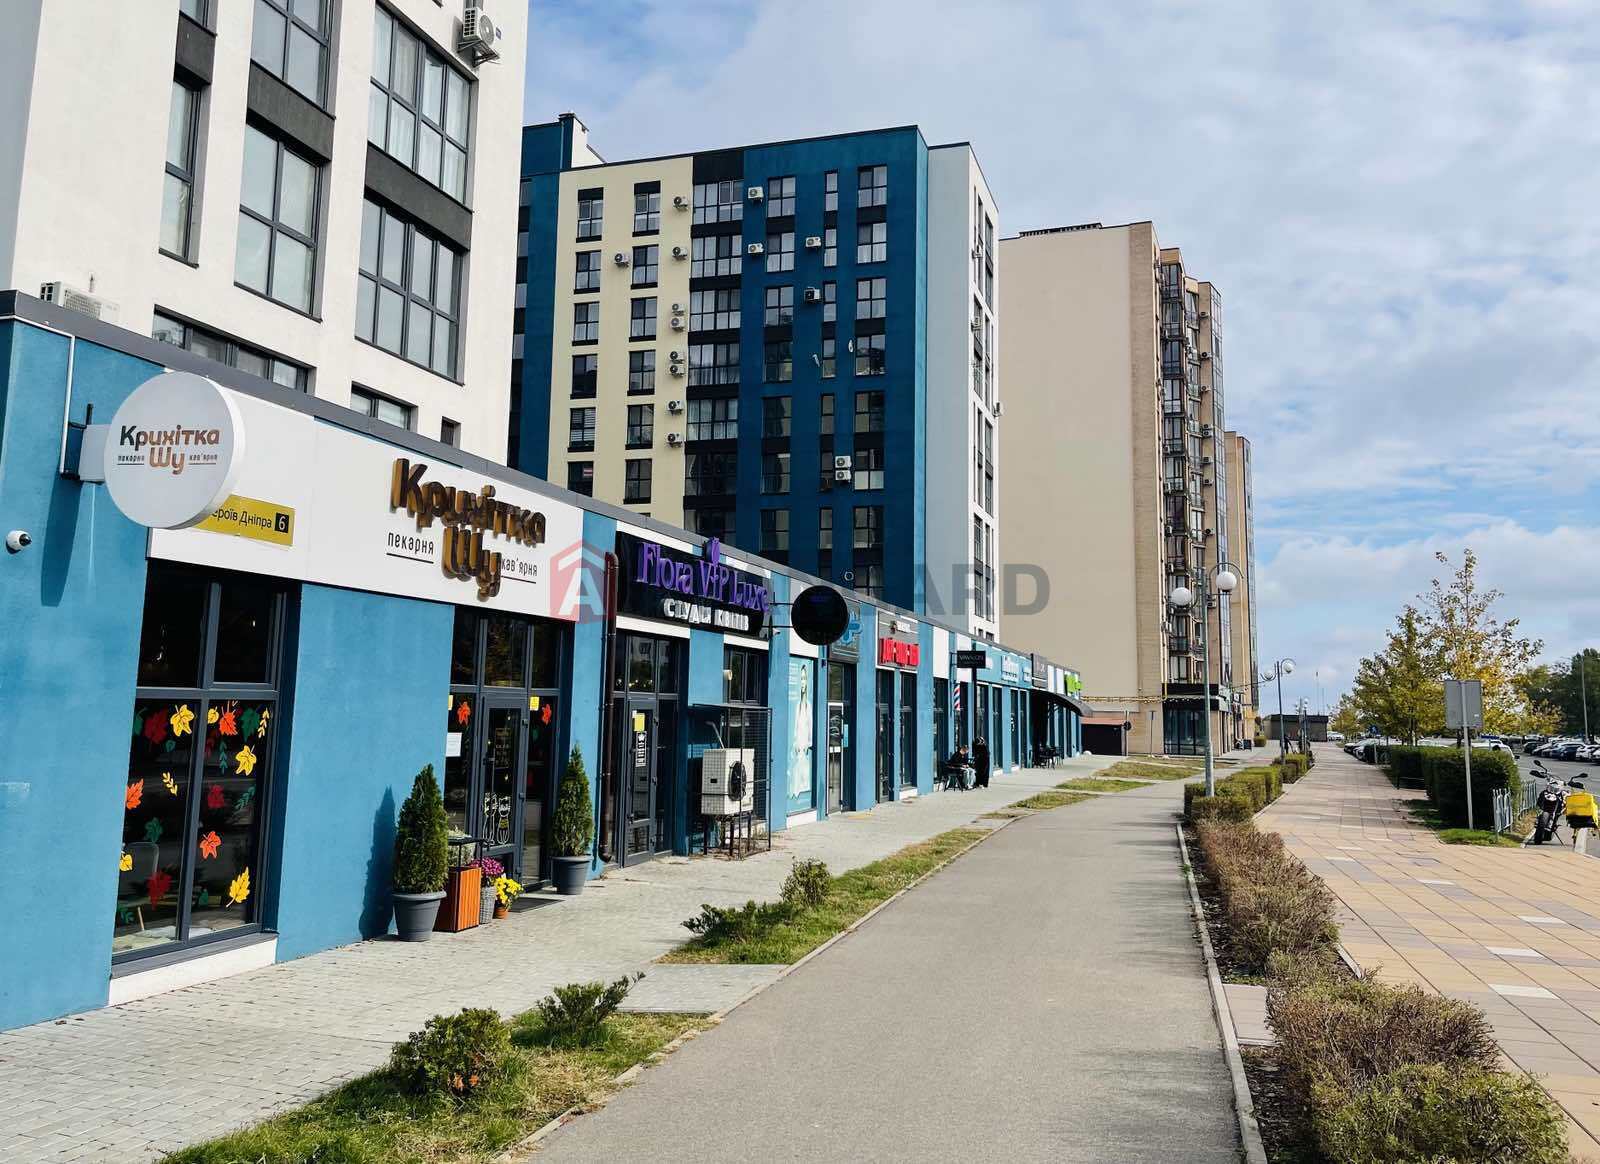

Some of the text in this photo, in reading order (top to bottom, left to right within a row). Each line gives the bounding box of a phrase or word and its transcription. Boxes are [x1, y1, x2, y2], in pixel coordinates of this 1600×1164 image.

[119, 424, 220, 451] Крихітка
[149, 446, 185, 475] Шу
[390, 458, 546, 547] Крихітка
[211, 508, 286, 530] ероїв Дніпра 6
[387, 531, 434, 555] пекарня
[441, 526, 502, 602] Шу
[501, 558, 538, 577] кав'ярня
[636, 541, 694, 595] Flora
